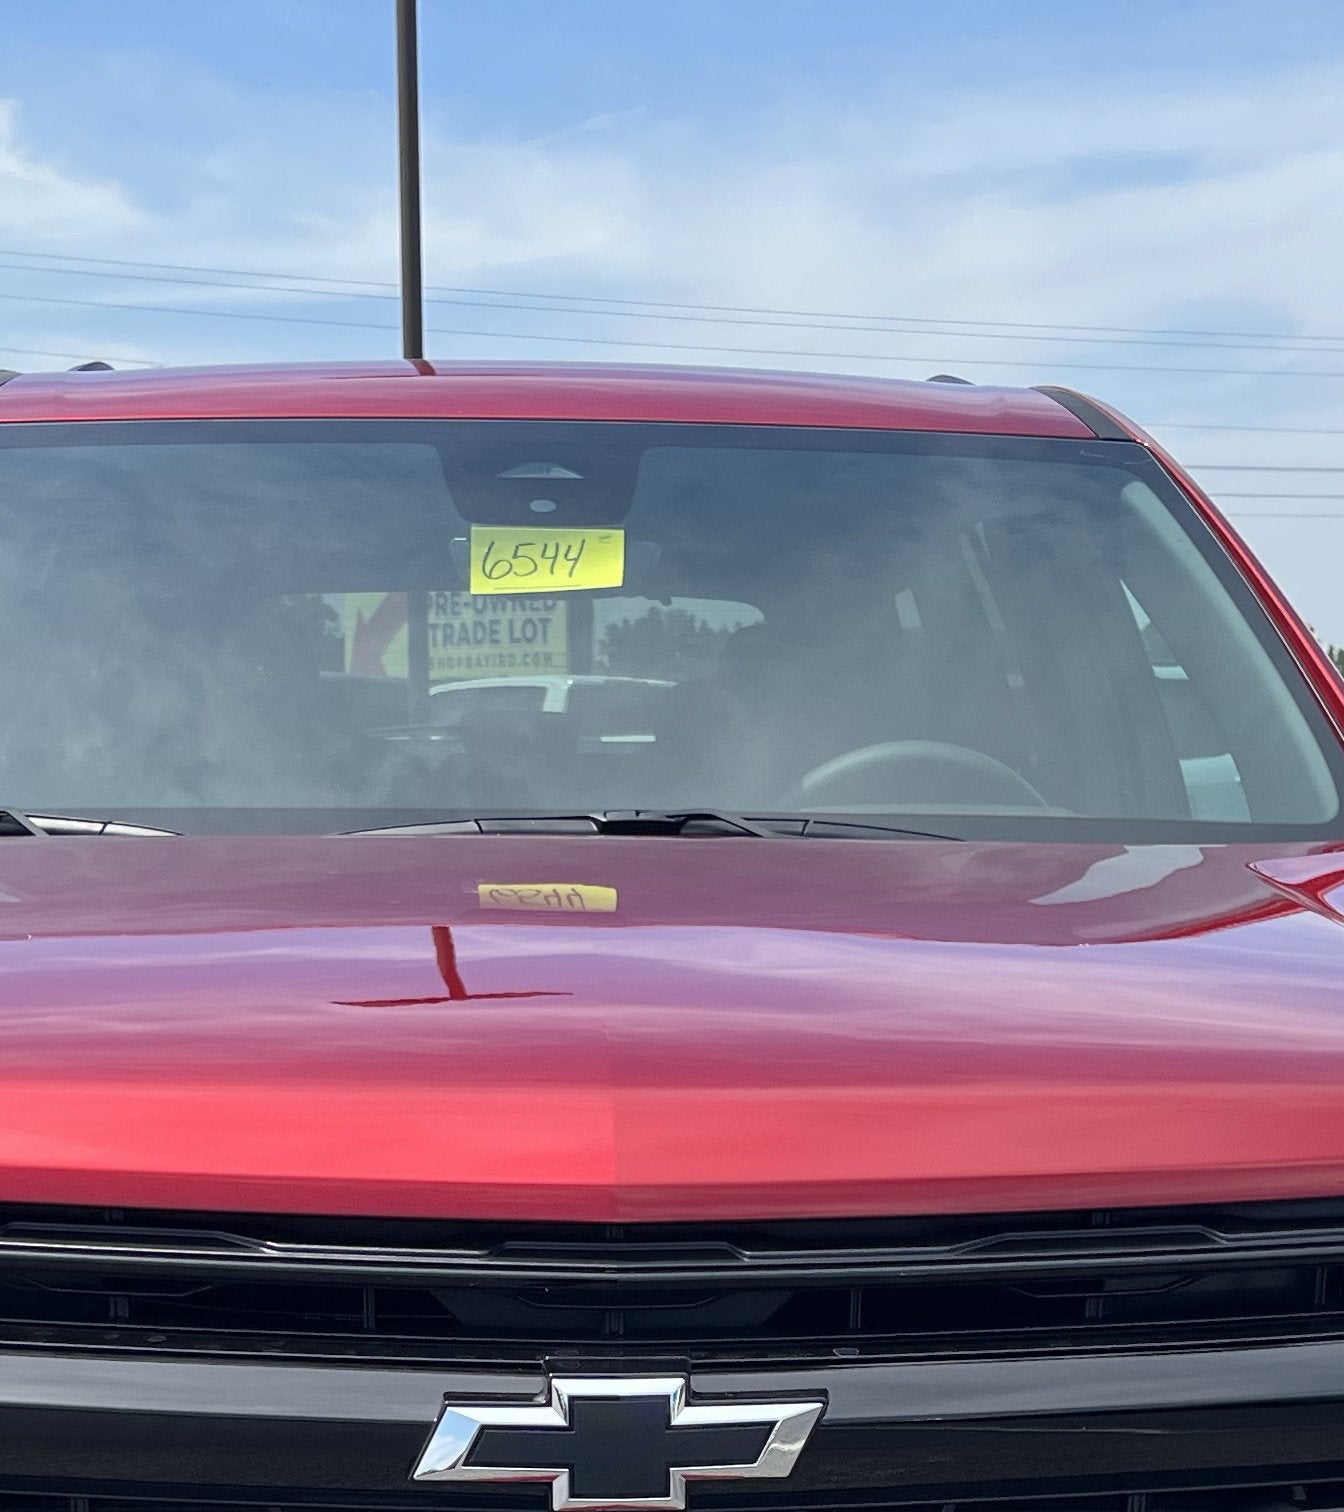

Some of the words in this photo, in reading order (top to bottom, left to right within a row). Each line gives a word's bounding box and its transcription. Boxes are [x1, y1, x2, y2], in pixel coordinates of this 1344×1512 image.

[482, 538, 586, 580] 6544
[428, 619, 501, 648] TRADE
[509, 617, 552, 644] LOT
